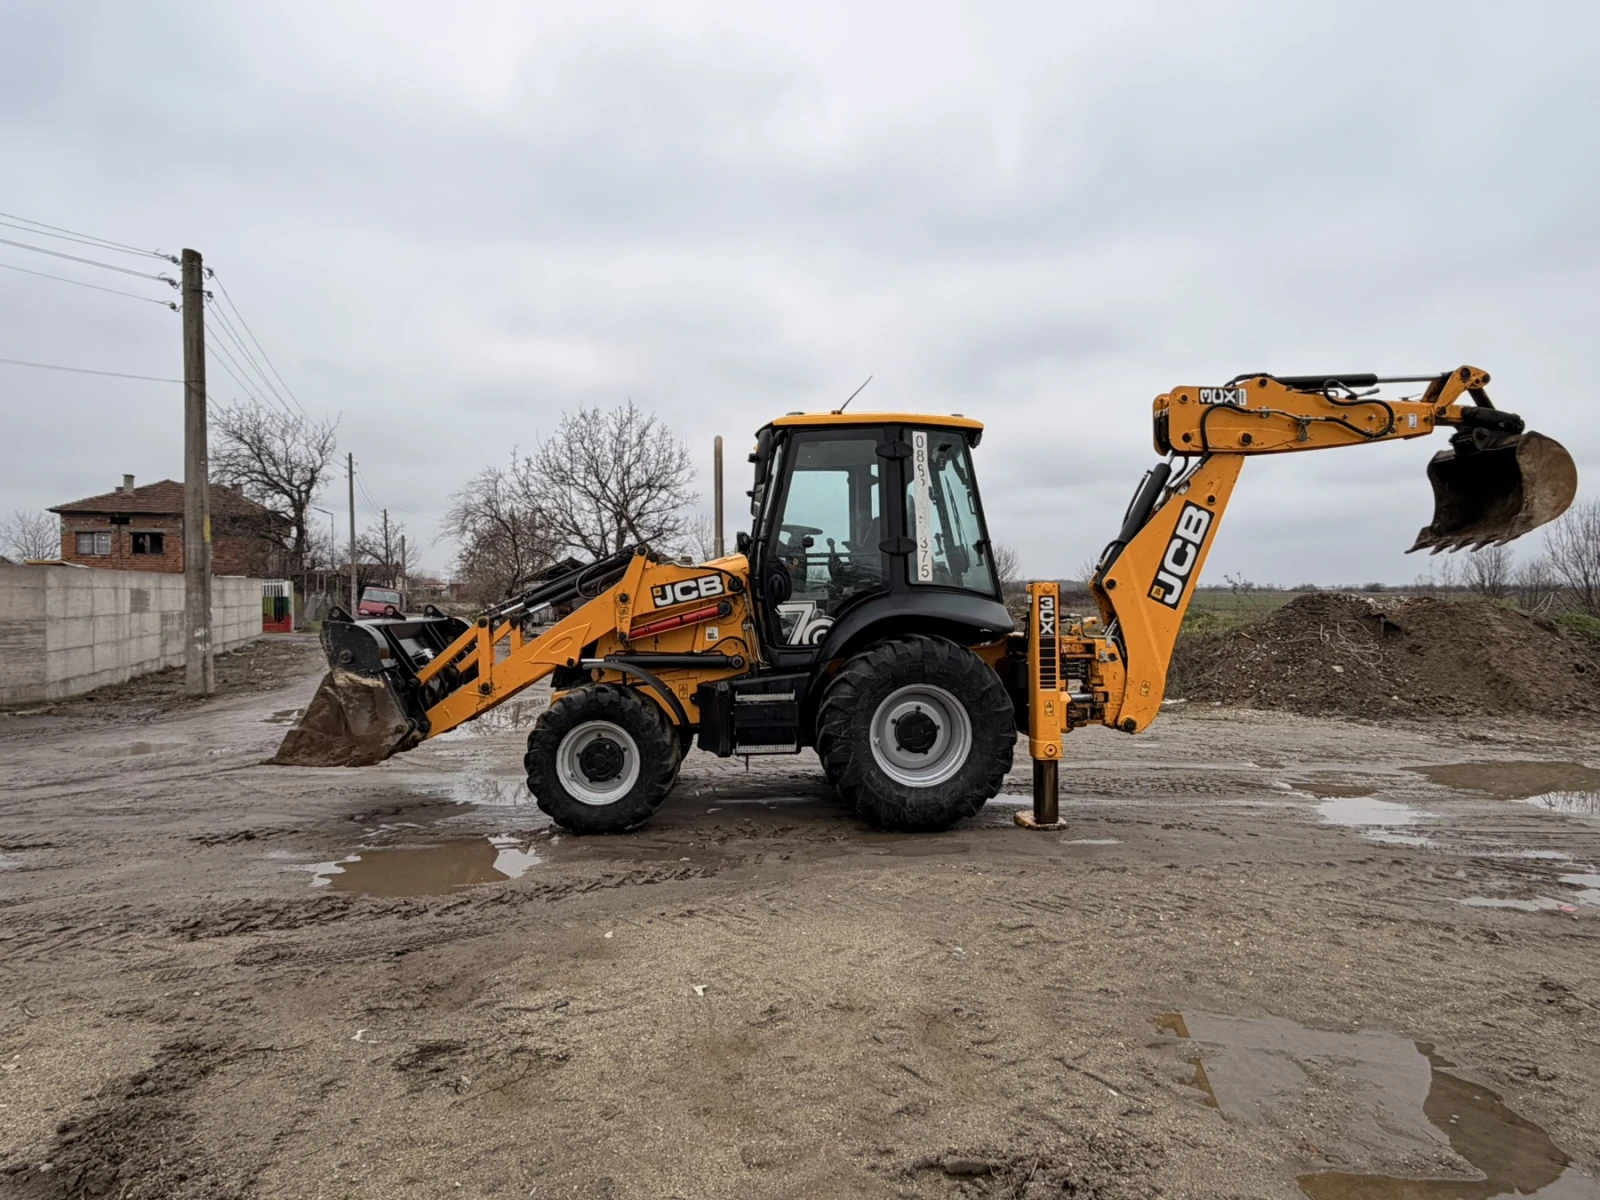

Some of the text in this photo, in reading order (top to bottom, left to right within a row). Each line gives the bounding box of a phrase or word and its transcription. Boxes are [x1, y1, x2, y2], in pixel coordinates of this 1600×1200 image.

[1157, 505, 1210, 604] JCB
[654, 575, 723, 606] JCB
[1040, 596, 1054, 634] 3CX
